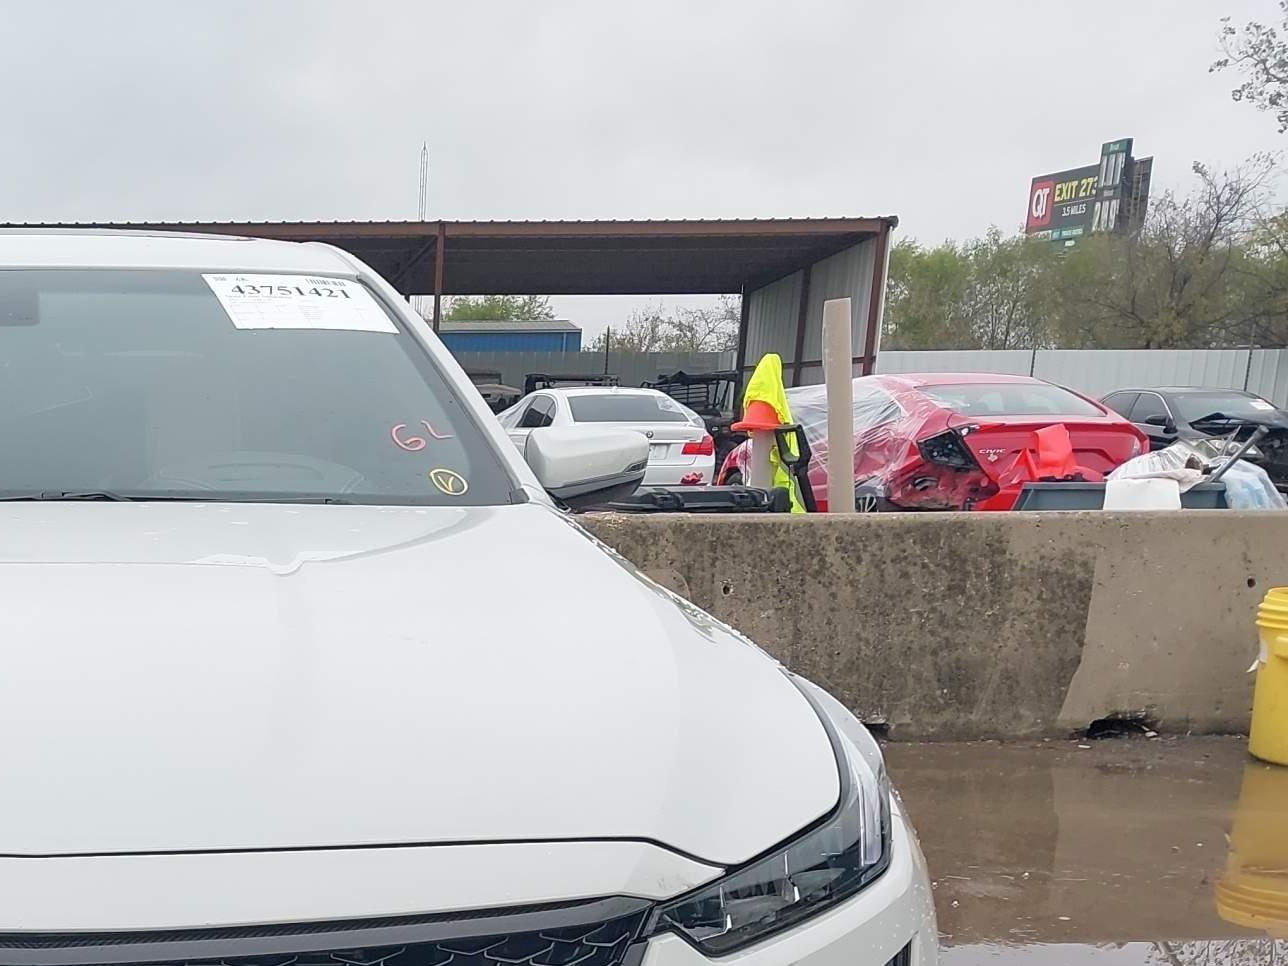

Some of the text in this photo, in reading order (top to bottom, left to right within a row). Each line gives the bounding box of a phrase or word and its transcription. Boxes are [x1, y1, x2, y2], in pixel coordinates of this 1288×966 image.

[1054, 180, 1079, 202] EXIT
[1032, 188, 1050, 219] QT
[231, 284, 352, 299] 43751421
